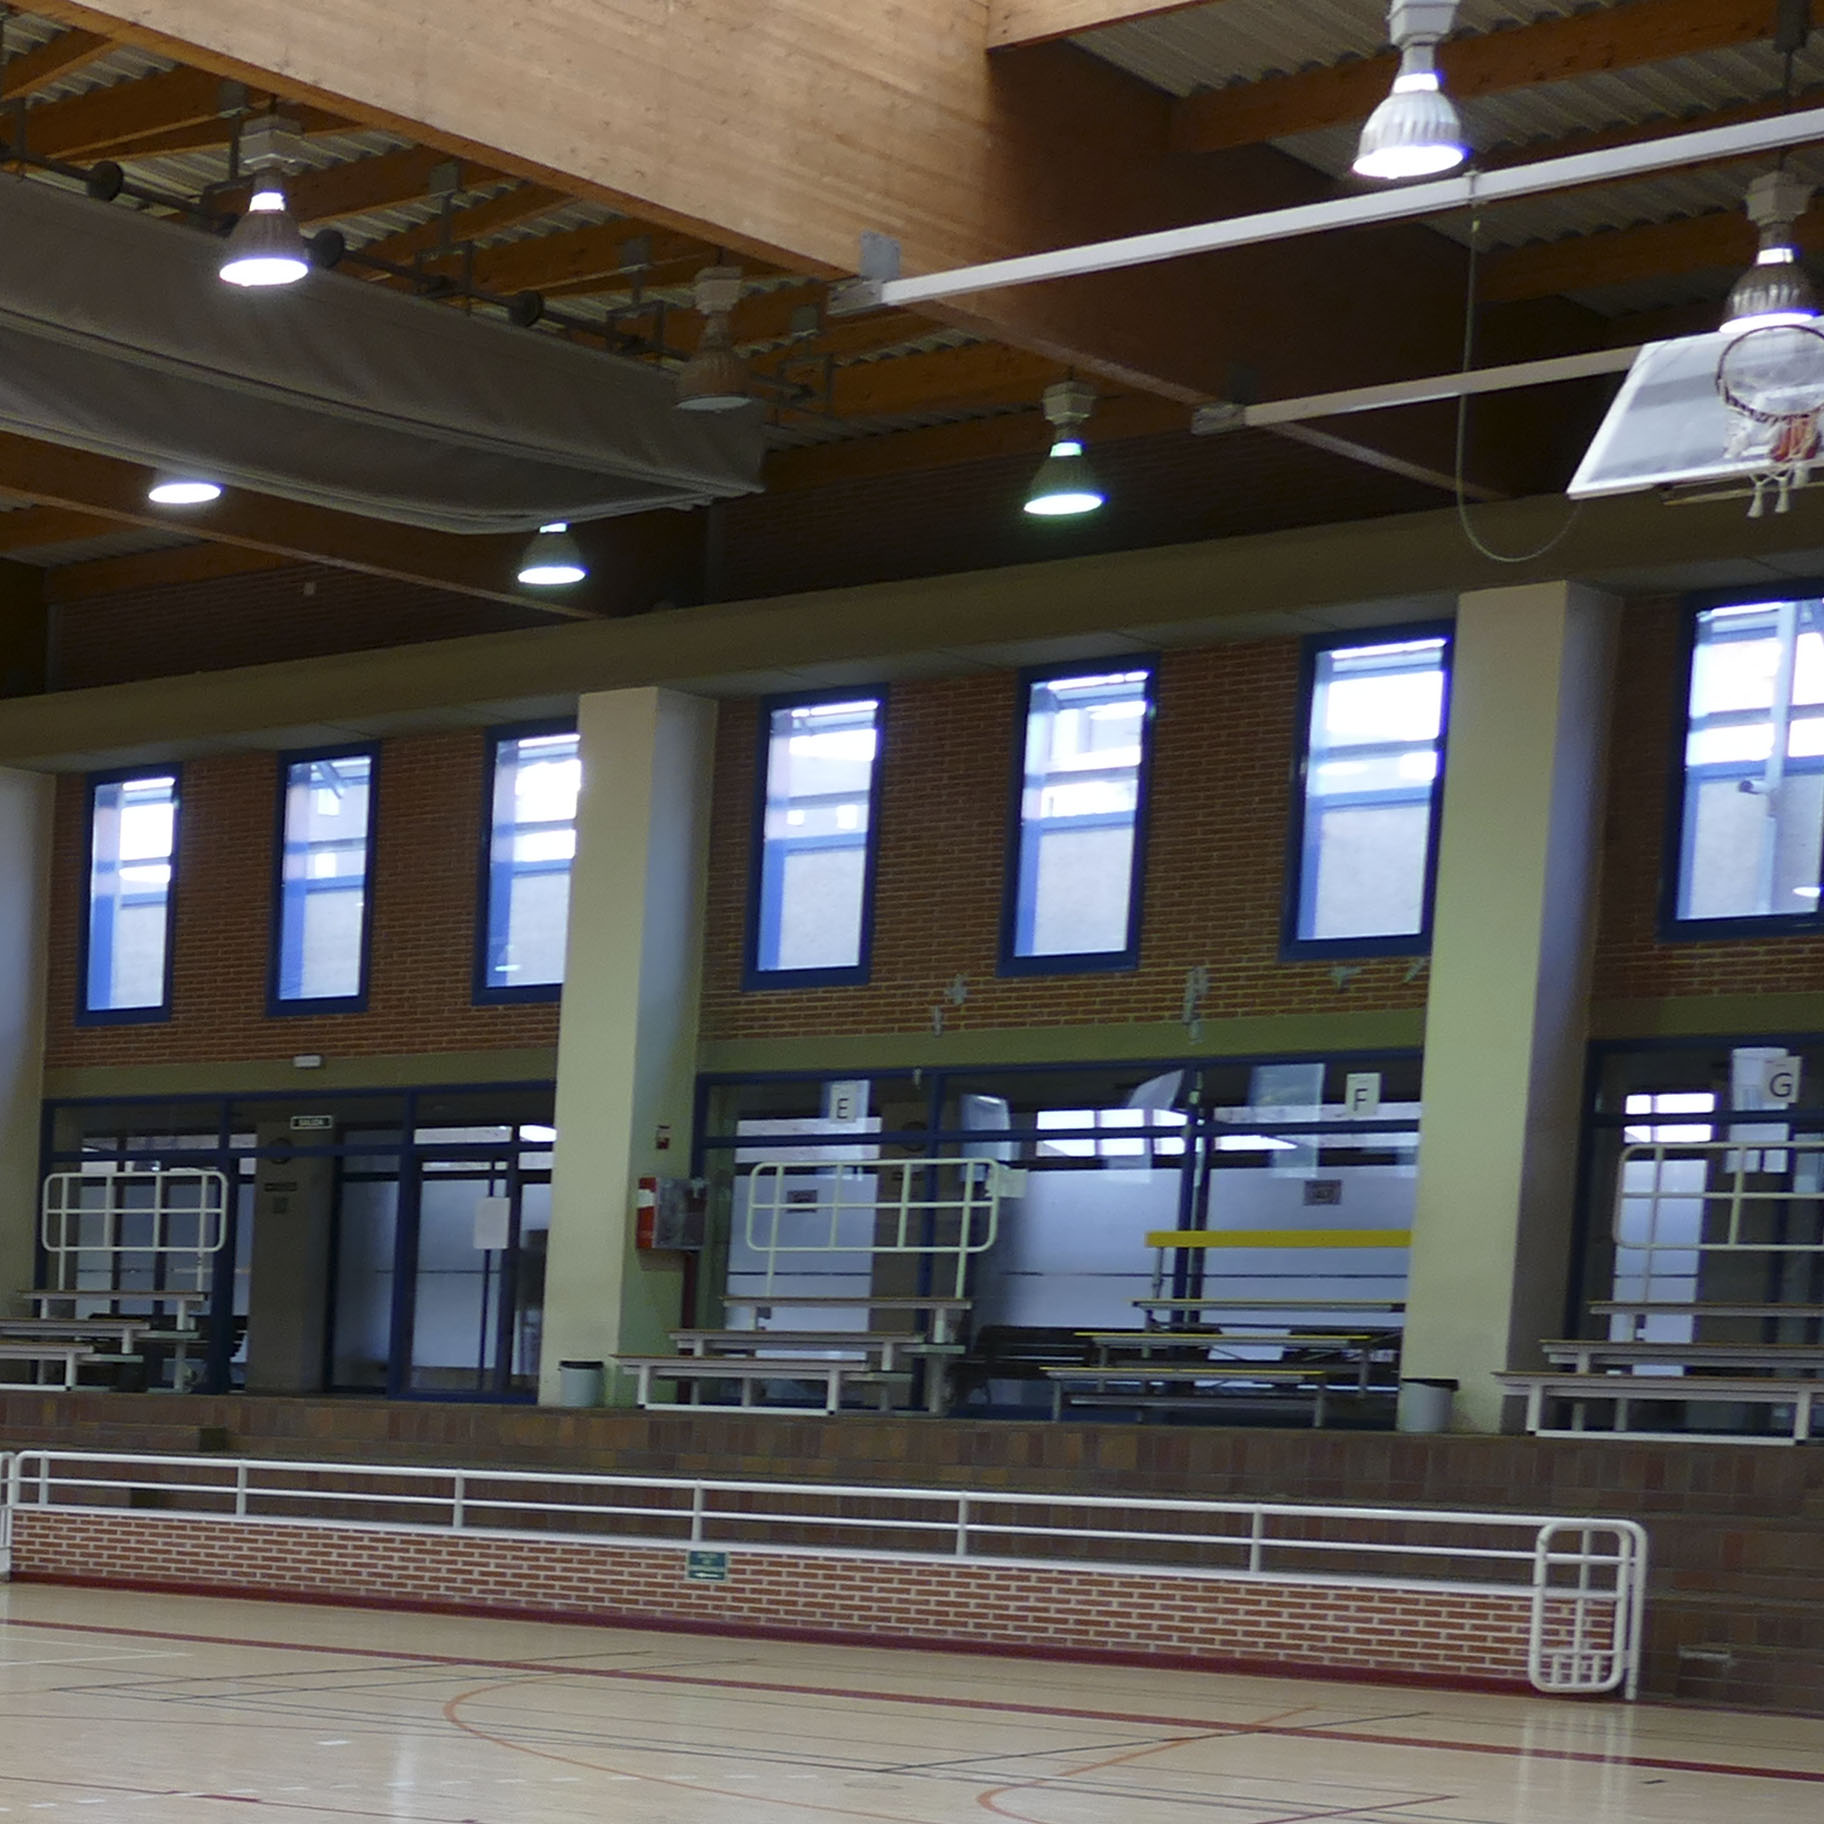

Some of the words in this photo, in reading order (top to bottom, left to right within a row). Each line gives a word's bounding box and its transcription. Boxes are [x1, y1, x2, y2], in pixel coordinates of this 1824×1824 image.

[1769, 1072, 1793, 1098] G
[836, 1097, 849, 1120] E
[1353, 1088, 1369, 1112] F
